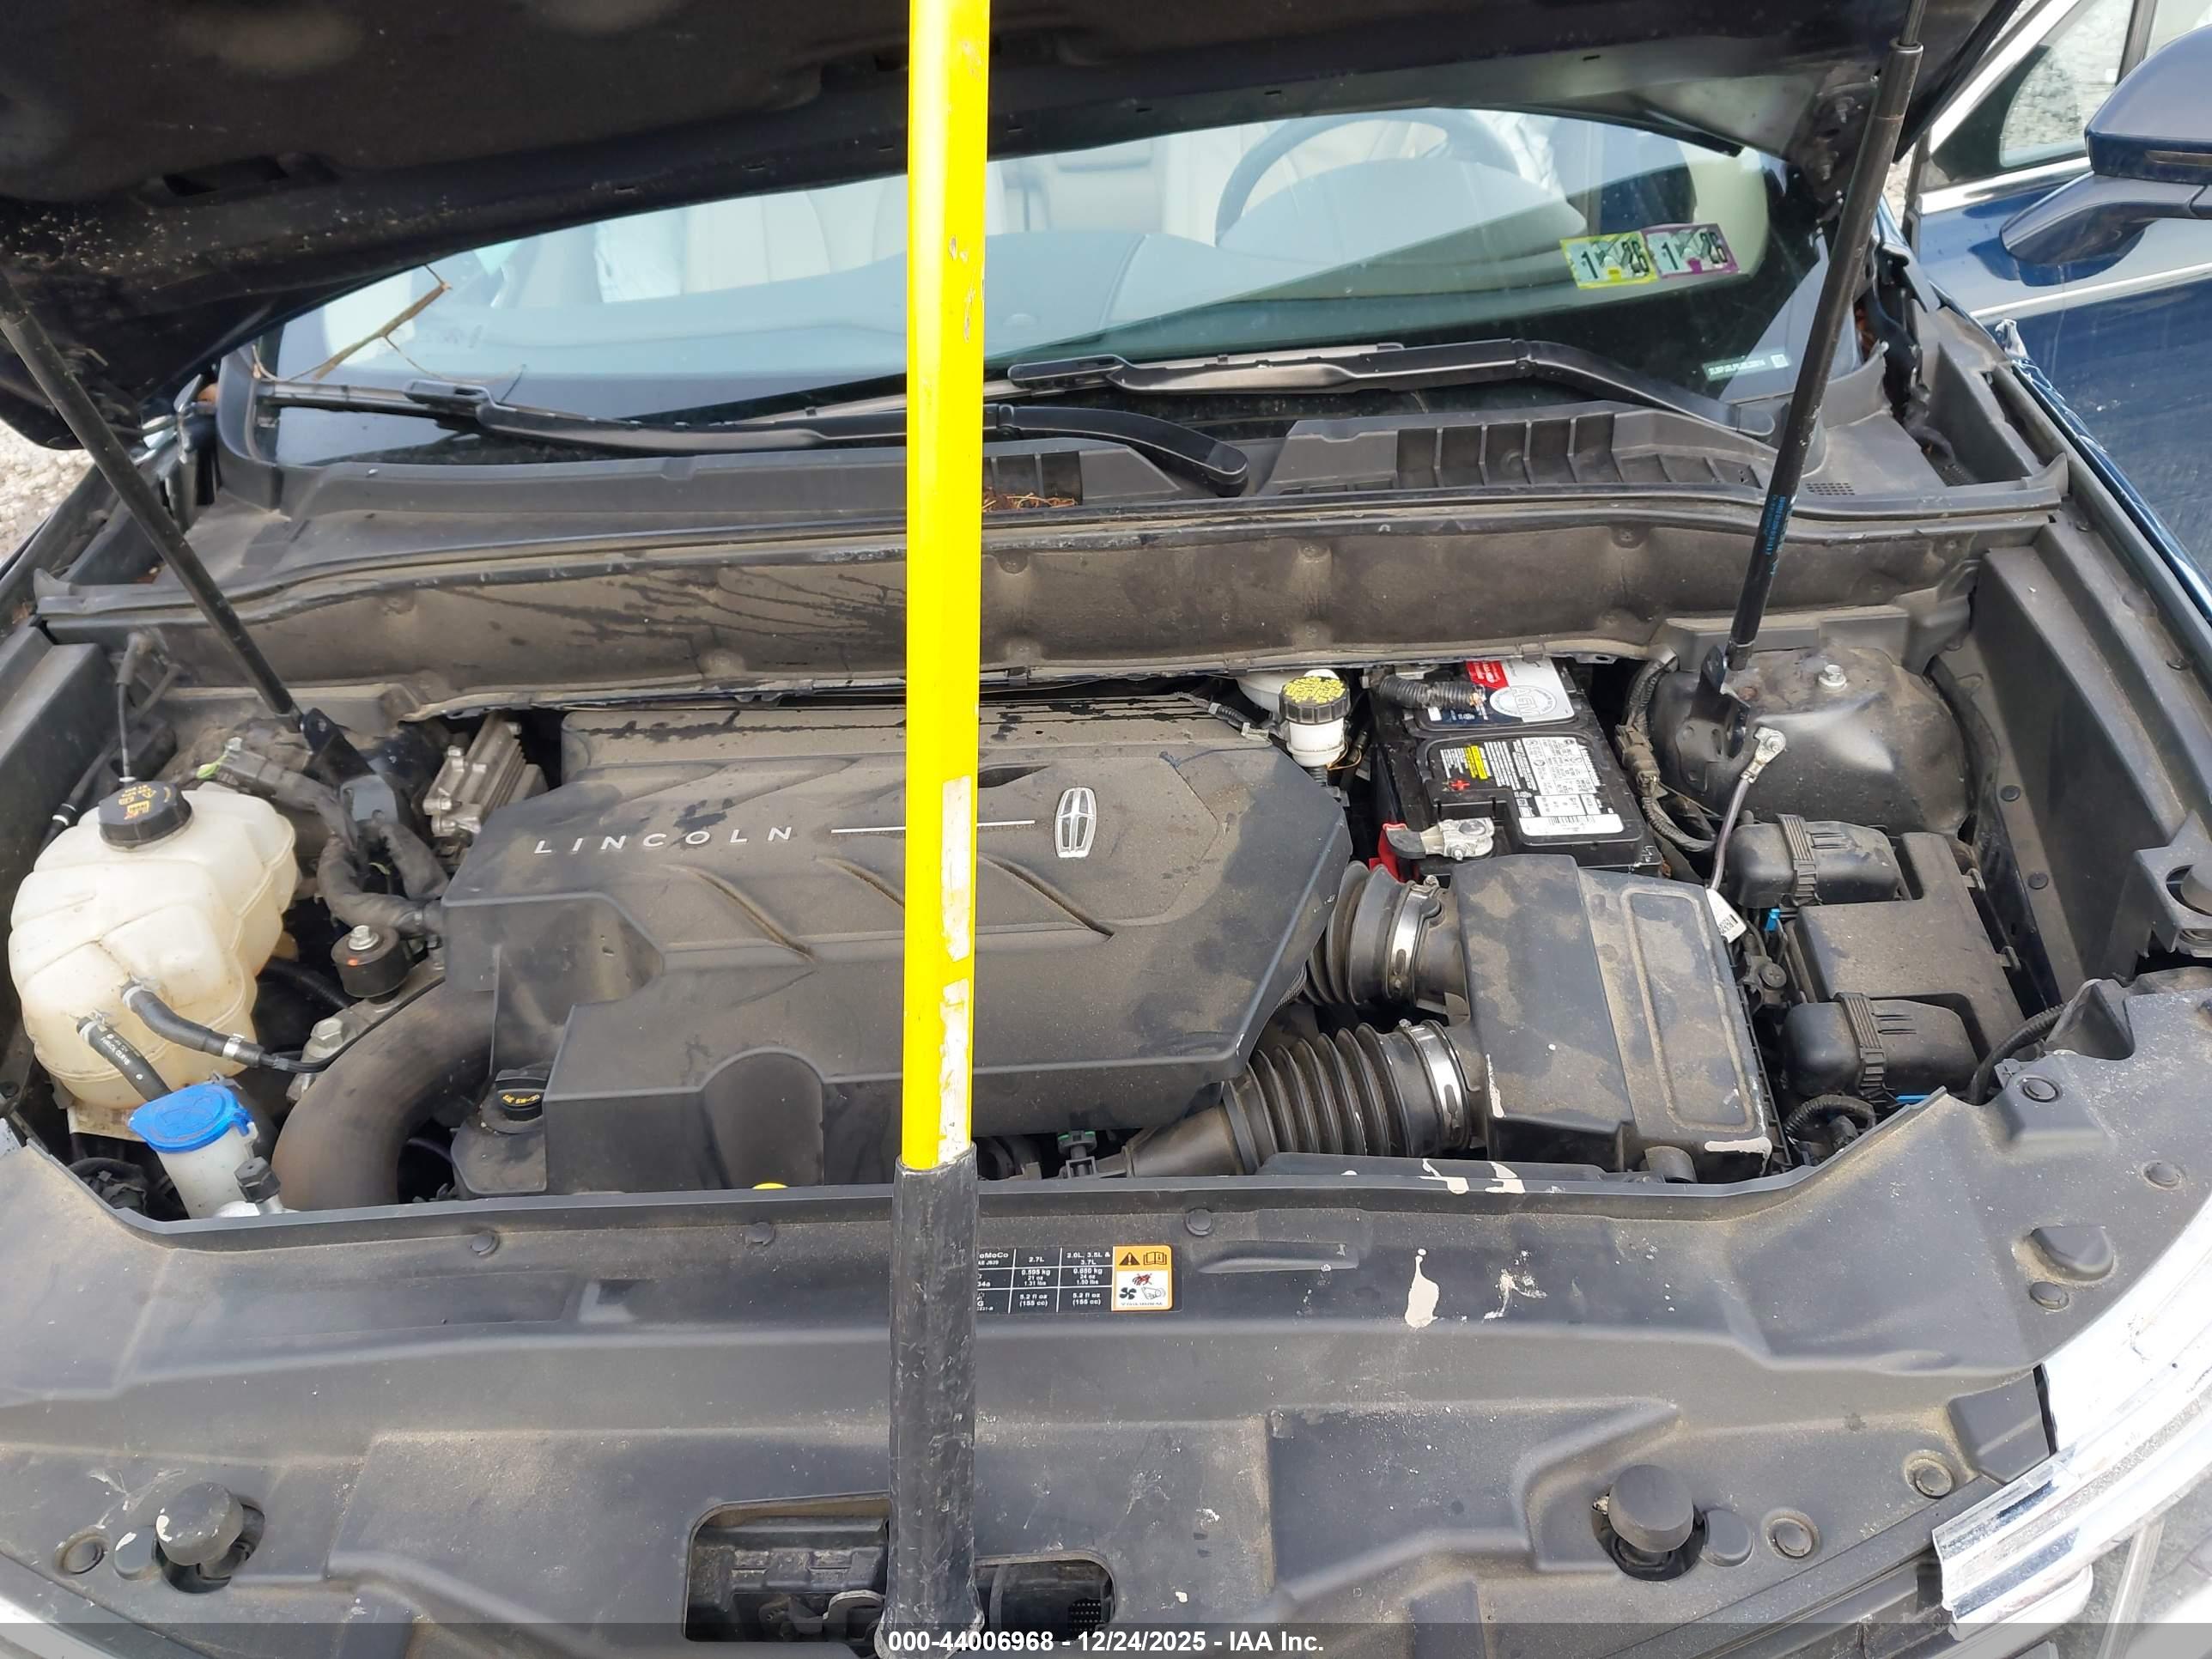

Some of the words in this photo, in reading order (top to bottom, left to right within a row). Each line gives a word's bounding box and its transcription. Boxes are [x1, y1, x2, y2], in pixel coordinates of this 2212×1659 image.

[1582, 251, 1599, 279] 1
[1662, 241, 1679, 270] 1
[1514, 687, 1540, 717] AGM
[534, 826, 792, 854] LINCOLN
[1042, 1268, 1051, 1277] kg
[1093, 1267, 1103, 1275] kg
